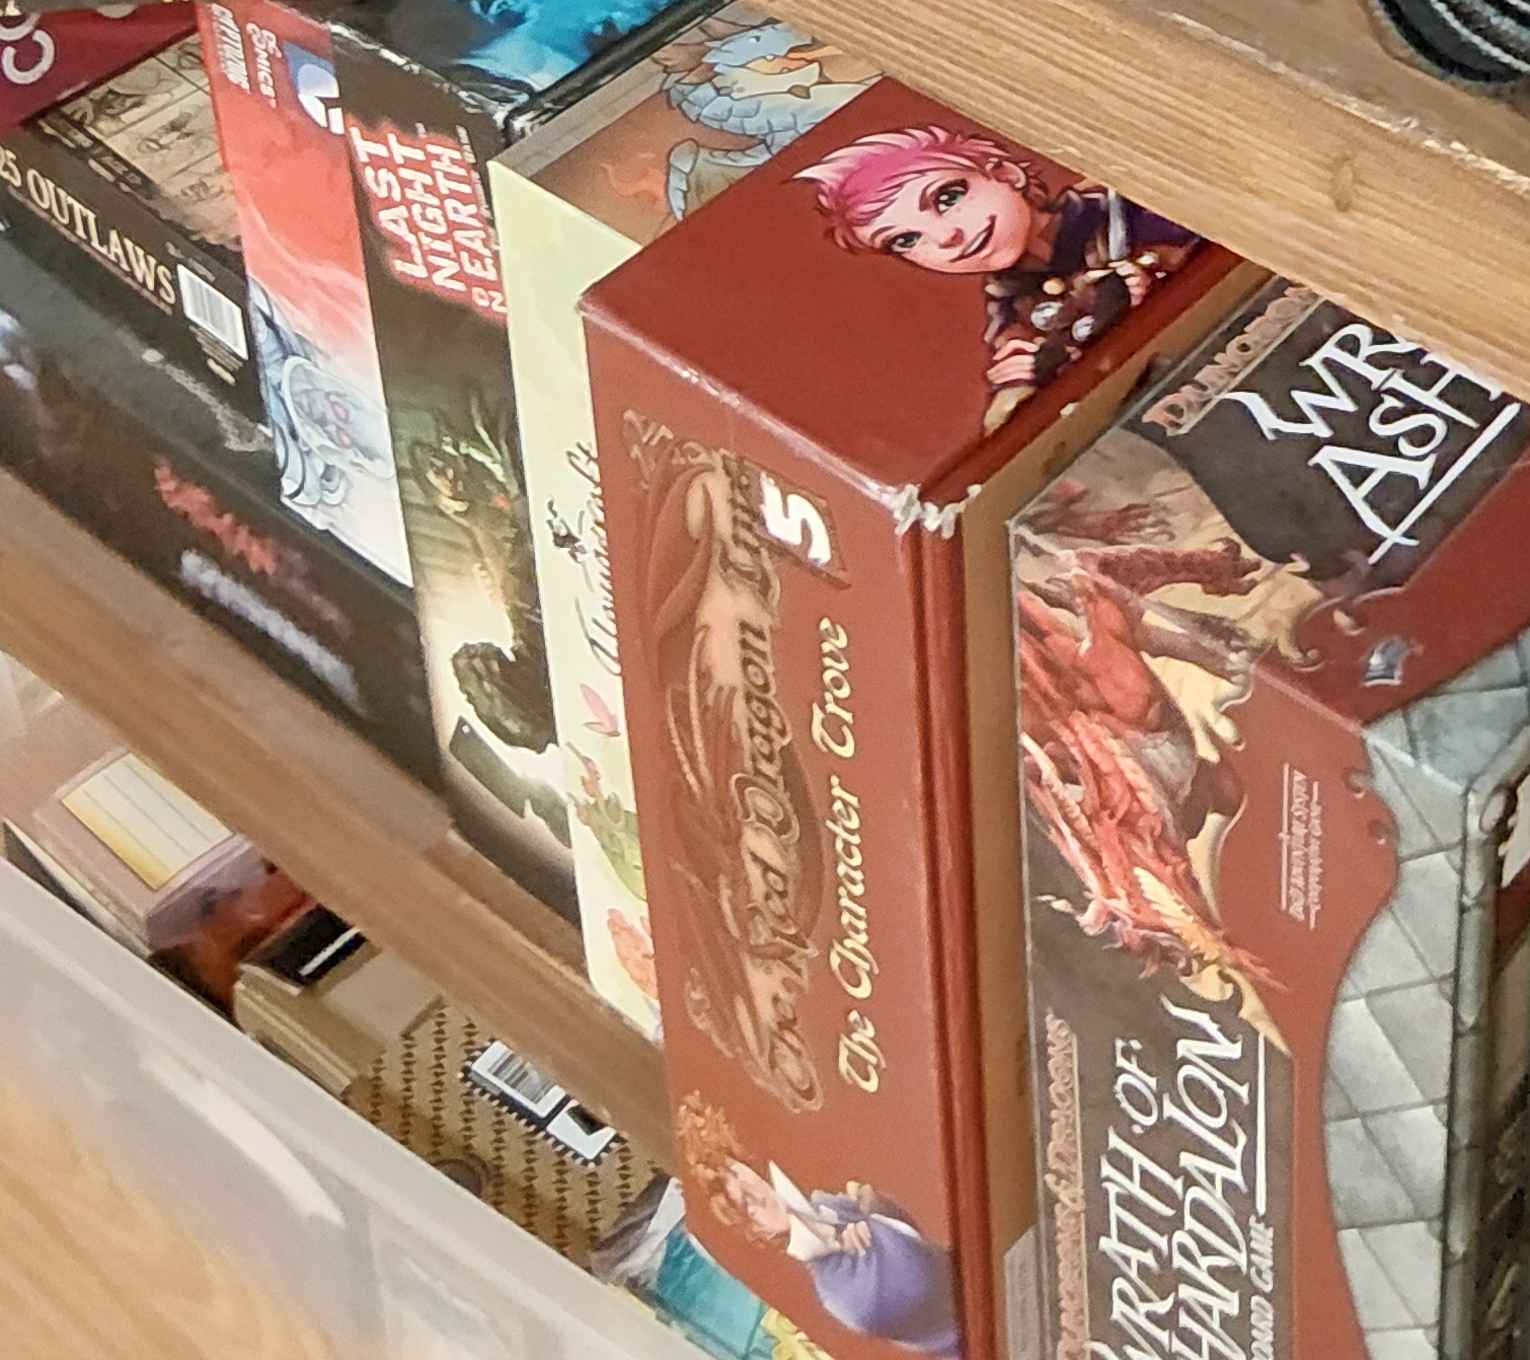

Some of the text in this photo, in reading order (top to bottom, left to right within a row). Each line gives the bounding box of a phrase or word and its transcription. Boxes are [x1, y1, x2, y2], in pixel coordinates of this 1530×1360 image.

[27, 168, 176, 305] OUTLAWS
[350, 127, 428, 279] LAST
[387, 133, 467, 292] NIGHT
[425, 143, 499, 282] EARTH
[759, 470, 832, 567] 5
[731, 620, 801, 843] Dragon
[811, 616, 887, 1093] The Character Trove
[1249, 1215, 1274, 1293] GAME
